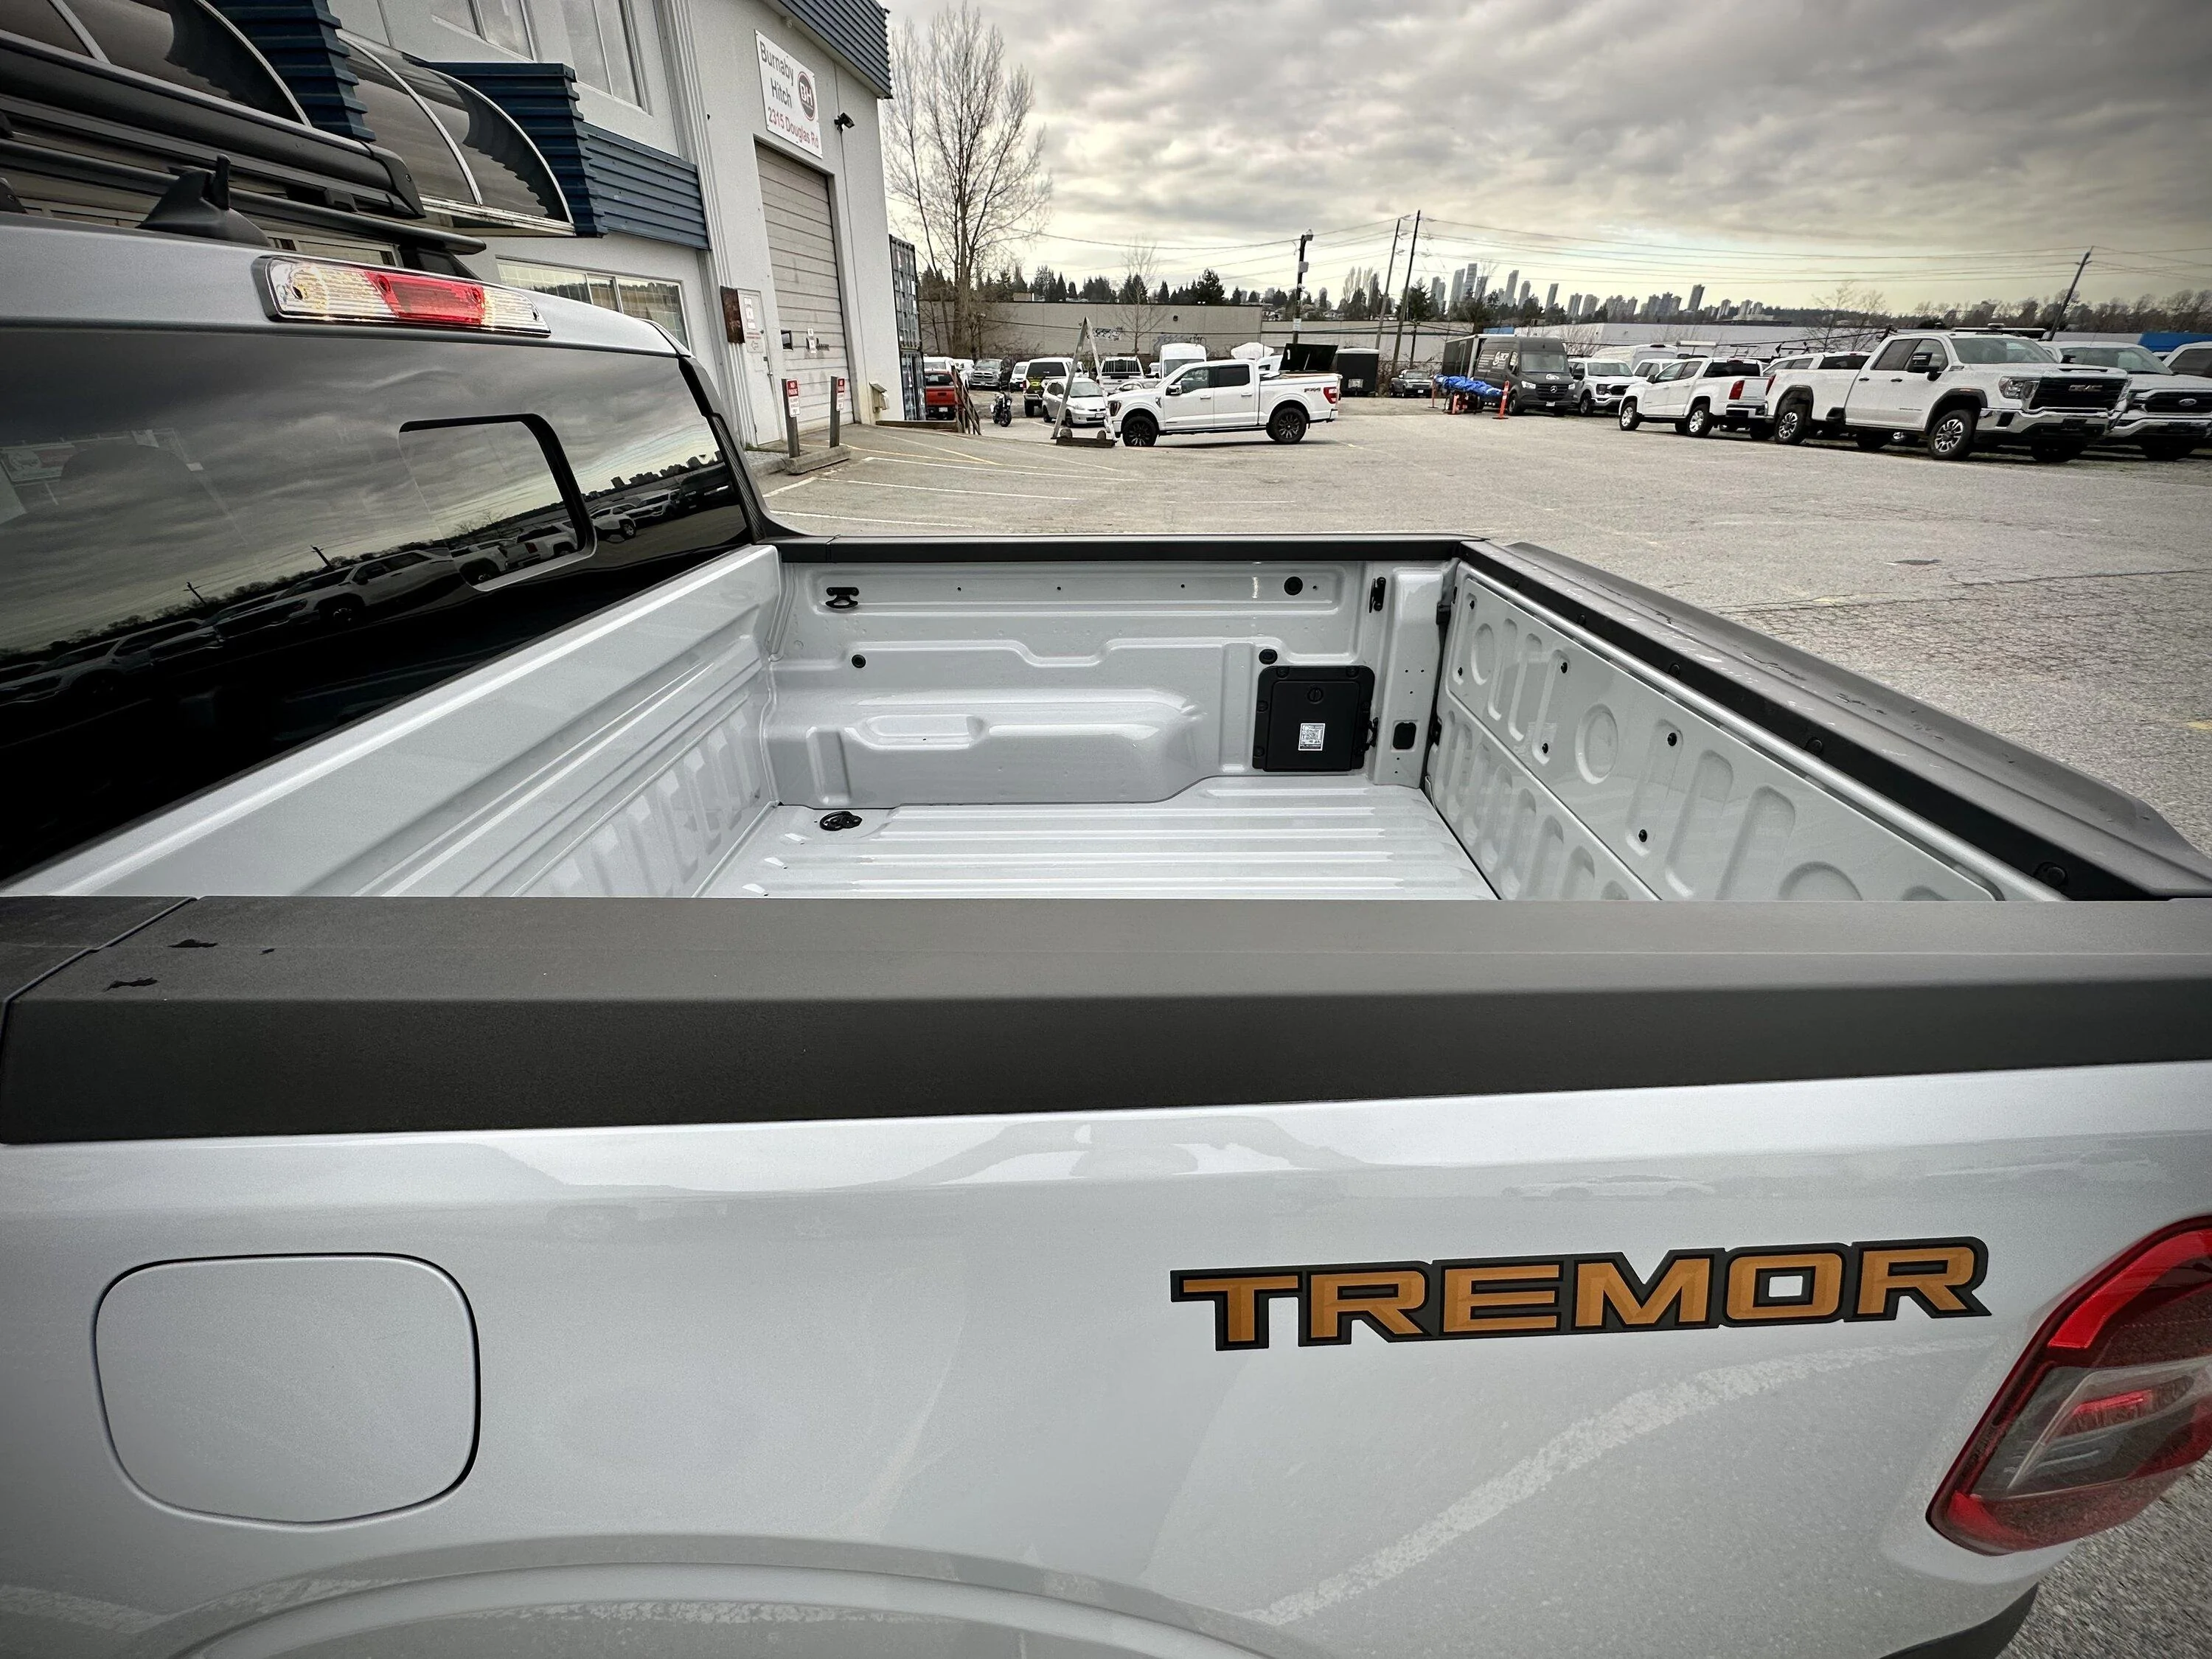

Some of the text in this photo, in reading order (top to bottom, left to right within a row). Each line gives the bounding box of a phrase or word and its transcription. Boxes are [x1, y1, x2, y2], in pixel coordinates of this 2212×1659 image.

[759, 40, 794, 86] Burnaby
[771, 77, 792, 108] Hitch
[785, 116, 810, 144] Douglas
[1170, 1236, 1992, 1351] TREMOR
